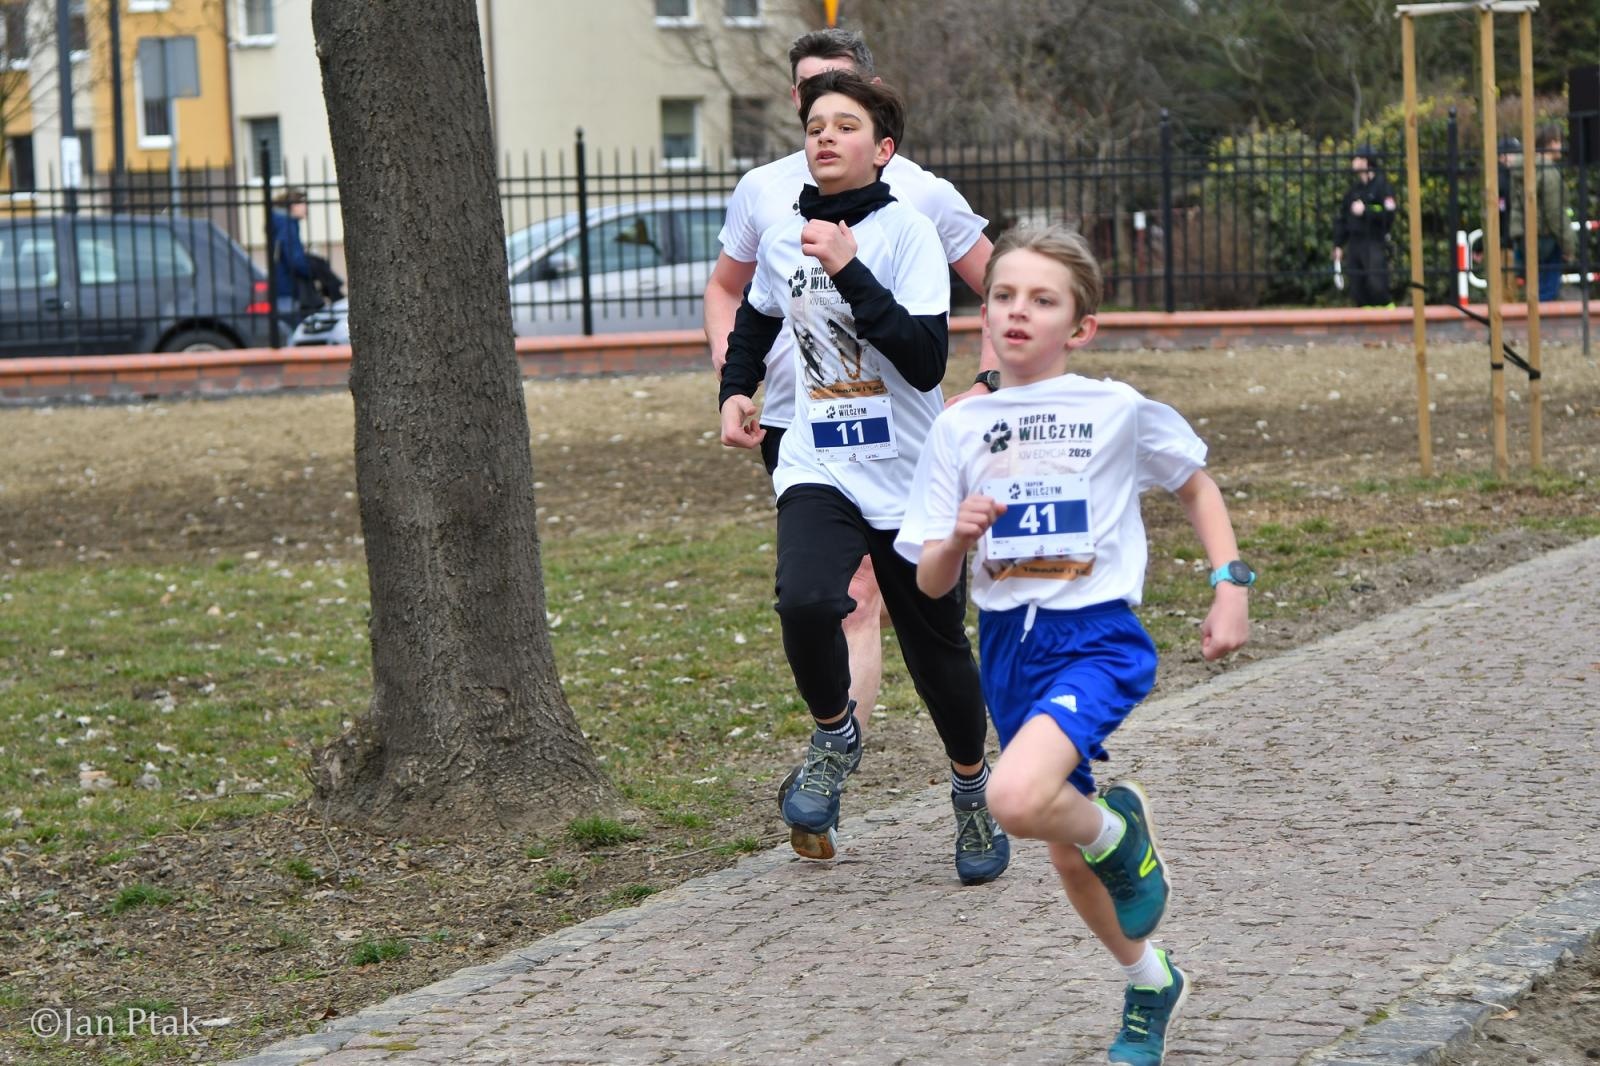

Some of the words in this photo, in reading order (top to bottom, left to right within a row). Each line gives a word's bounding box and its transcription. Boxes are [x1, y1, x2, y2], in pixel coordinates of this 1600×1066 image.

[839, 407, 867, 417] WILCZYM
[1019, 413, 1056, 426] TROPEM
[836, 421, 864, 445] 11
[1019, 423, 1093, 441] WILCZYM
[1068, 448, 1092, 458] 2026
[1025, 486, 1062, 497] WILCZYM
[1018, 503, 1056, 534] 41
